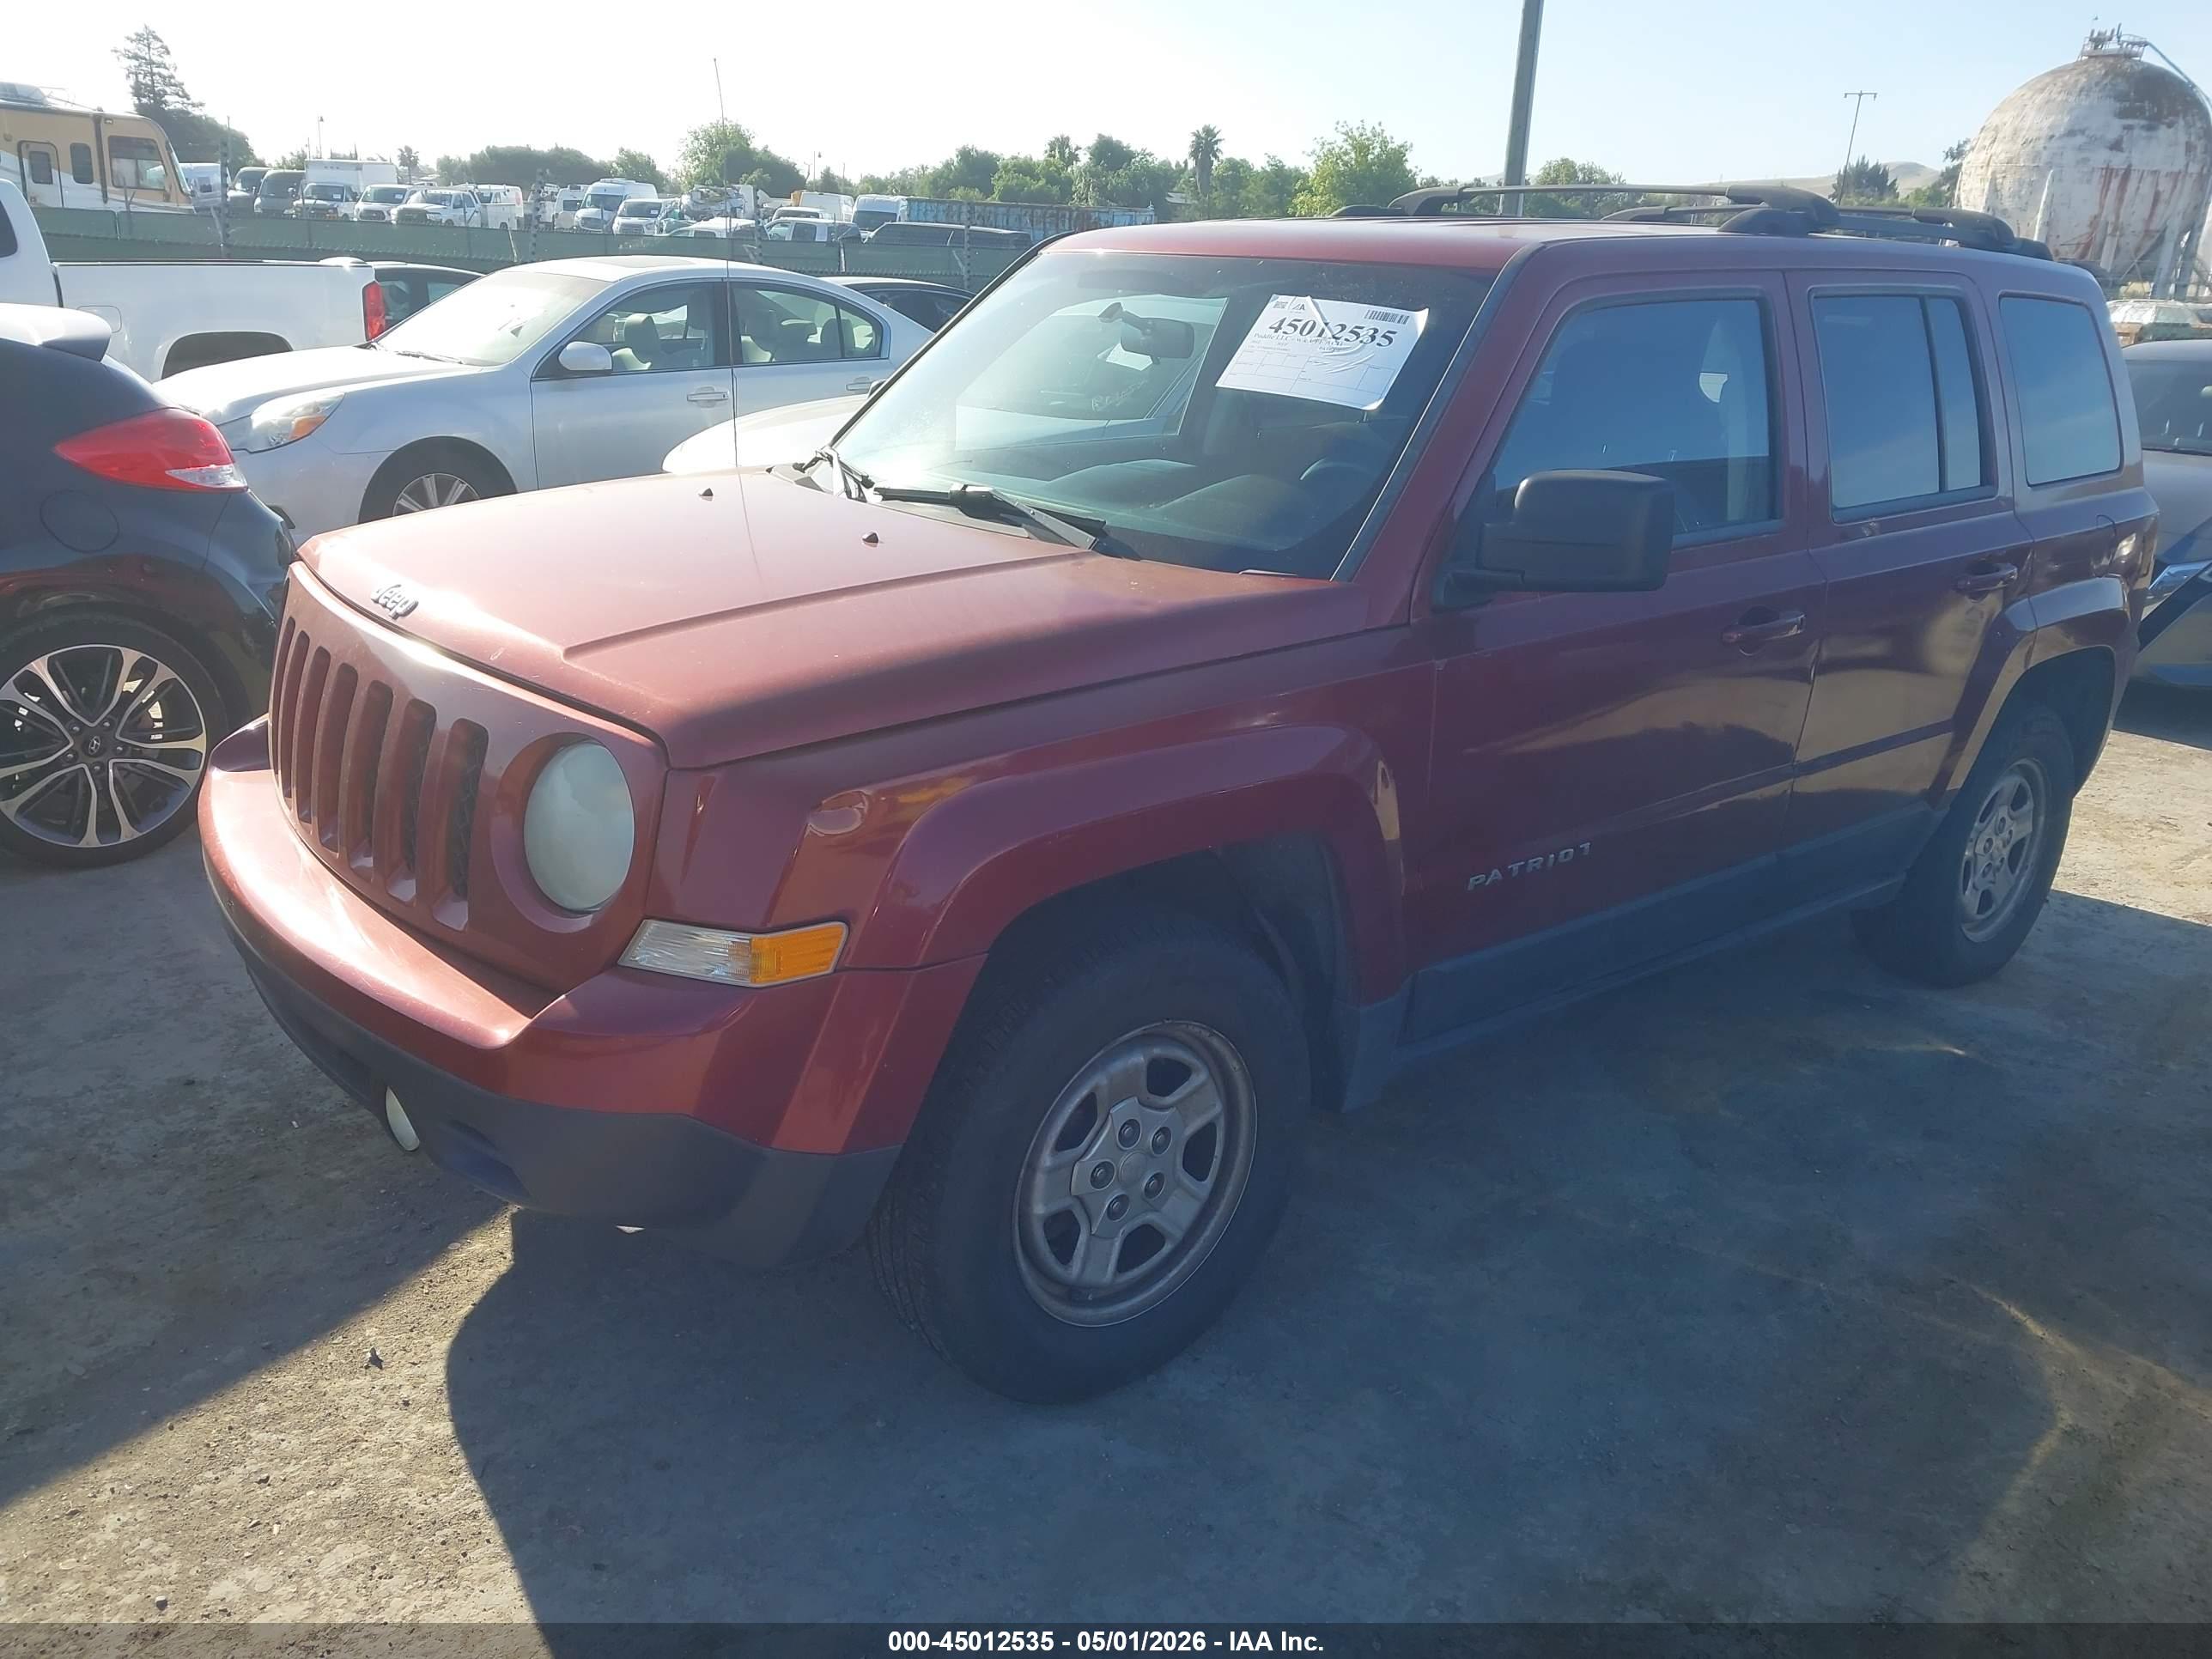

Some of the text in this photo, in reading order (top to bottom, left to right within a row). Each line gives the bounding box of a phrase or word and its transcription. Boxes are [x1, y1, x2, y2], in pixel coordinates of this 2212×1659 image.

[1269, 316, 1399, 348] 45012535
[371, 584, 419, 620] Jeep
[1467, 842, 1592, 891] PATRIOT
